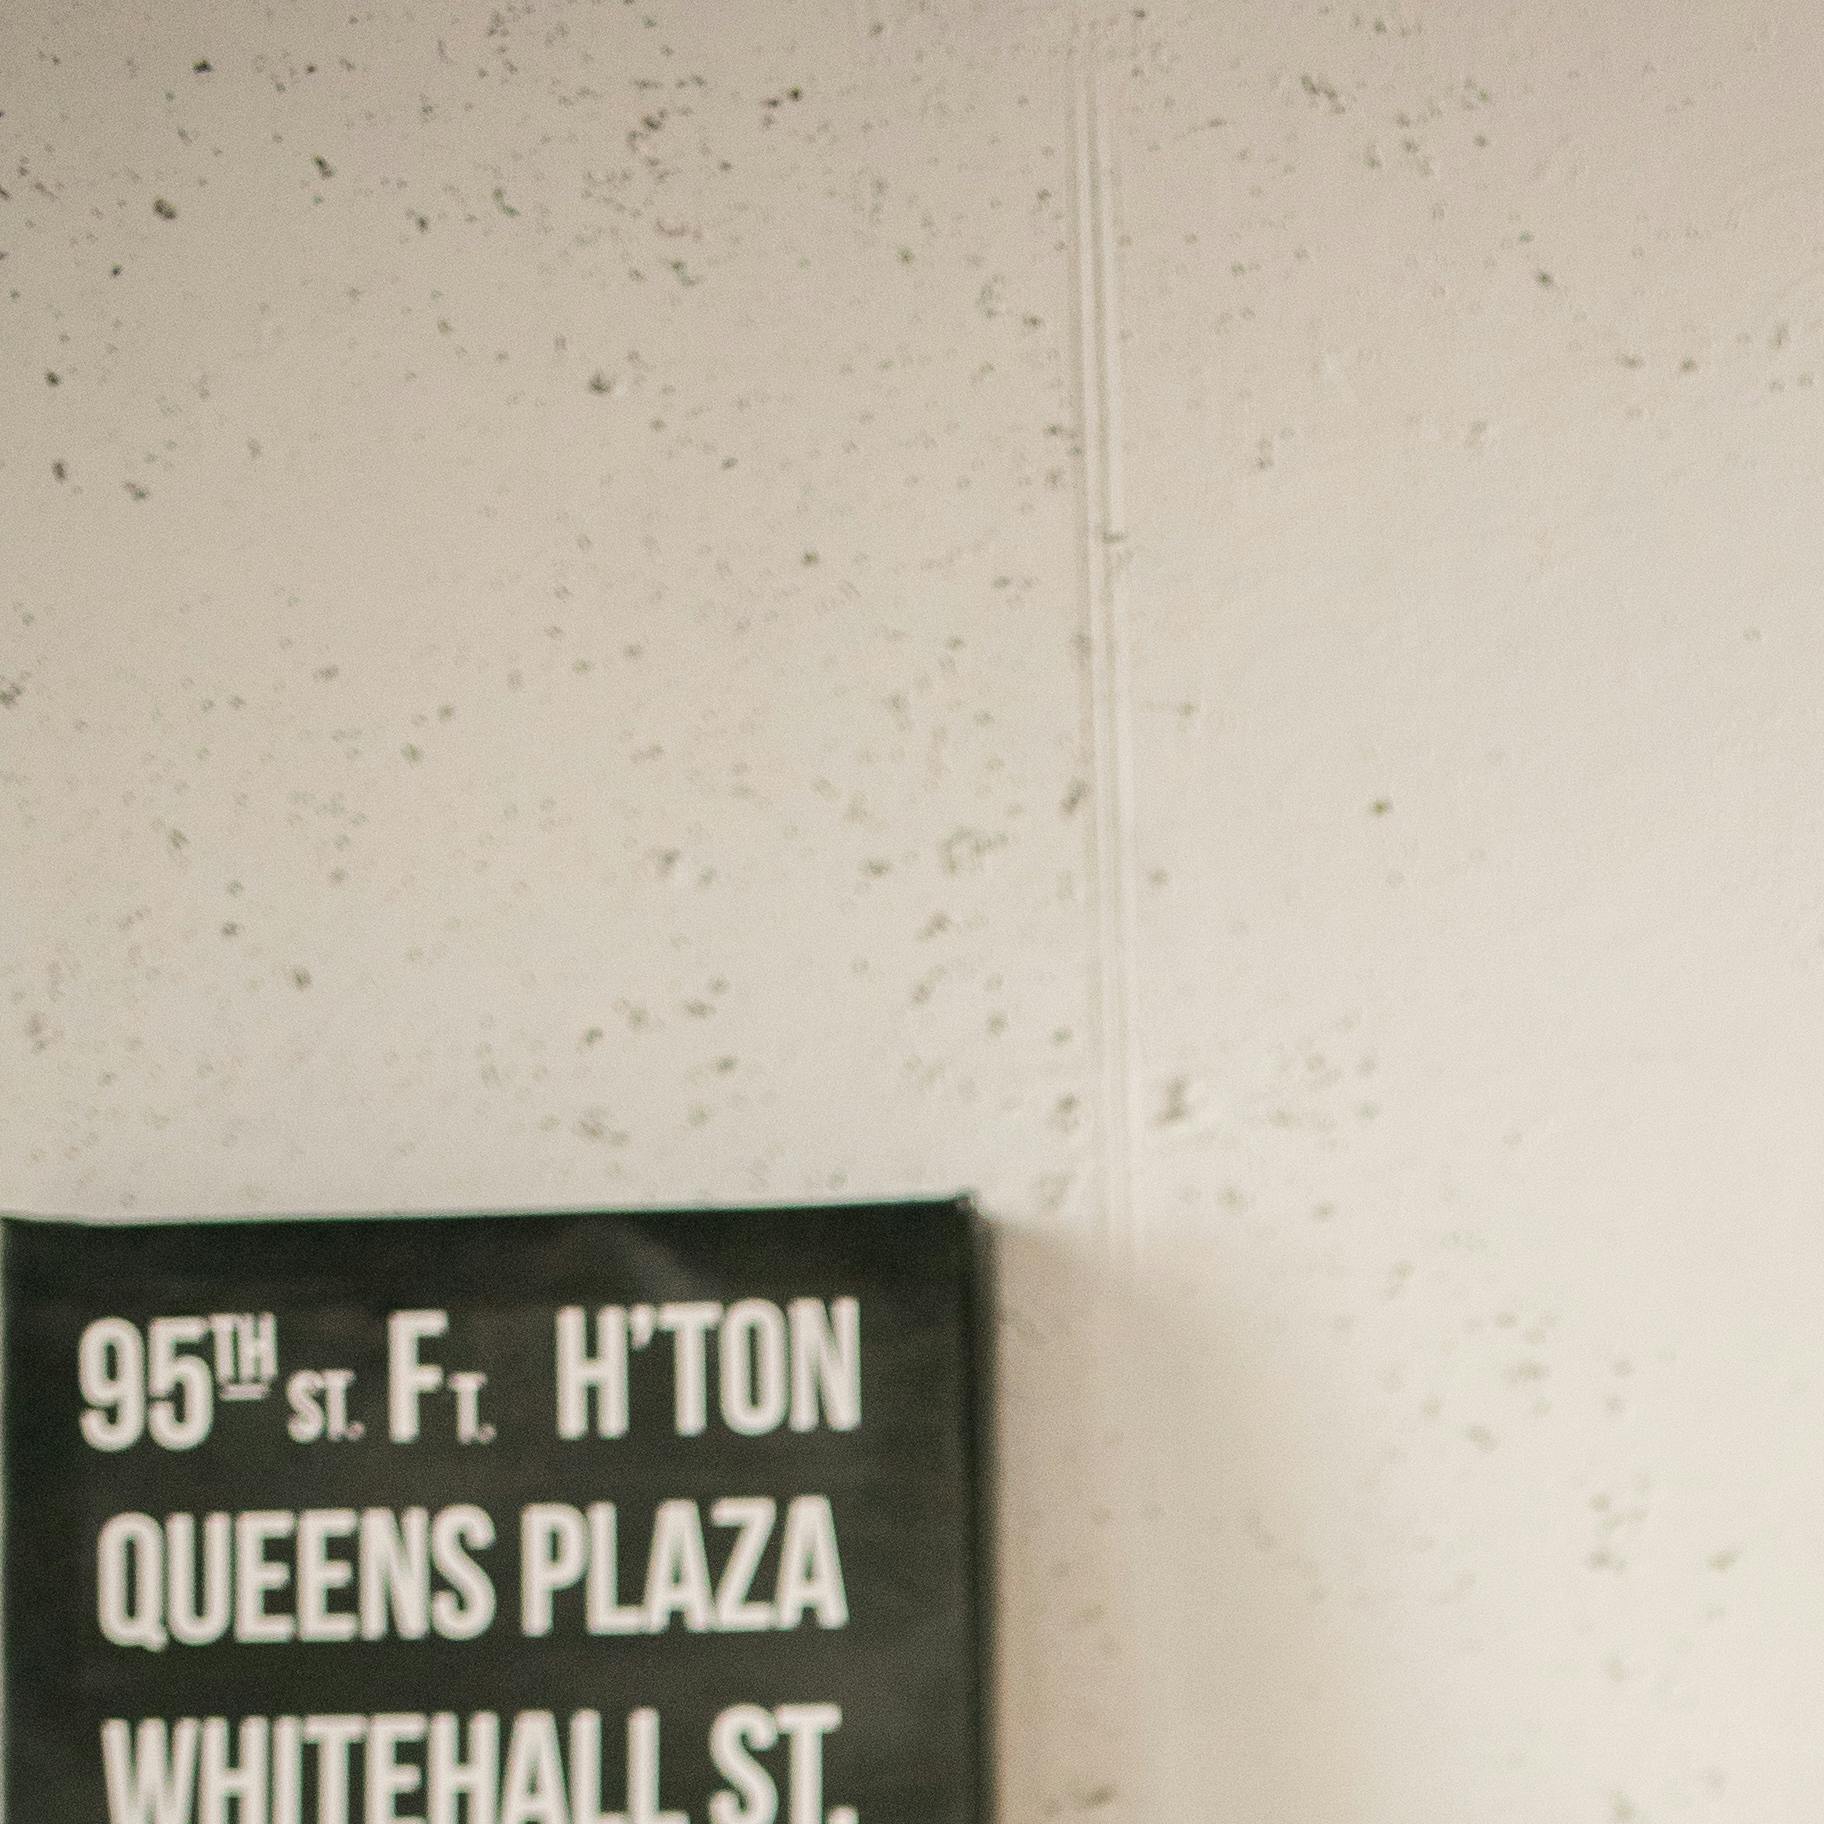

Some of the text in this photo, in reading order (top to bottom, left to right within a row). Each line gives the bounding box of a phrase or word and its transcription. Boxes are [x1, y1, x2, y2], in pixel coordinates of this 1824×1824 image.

[79, 1313, 278, 1451] 95TH
[286, 1370, 366, 1443] ST.
[555, 1296, 862, 1440] H'TON
[97, 1494, 849, 1651] QUEENS PLAZA
